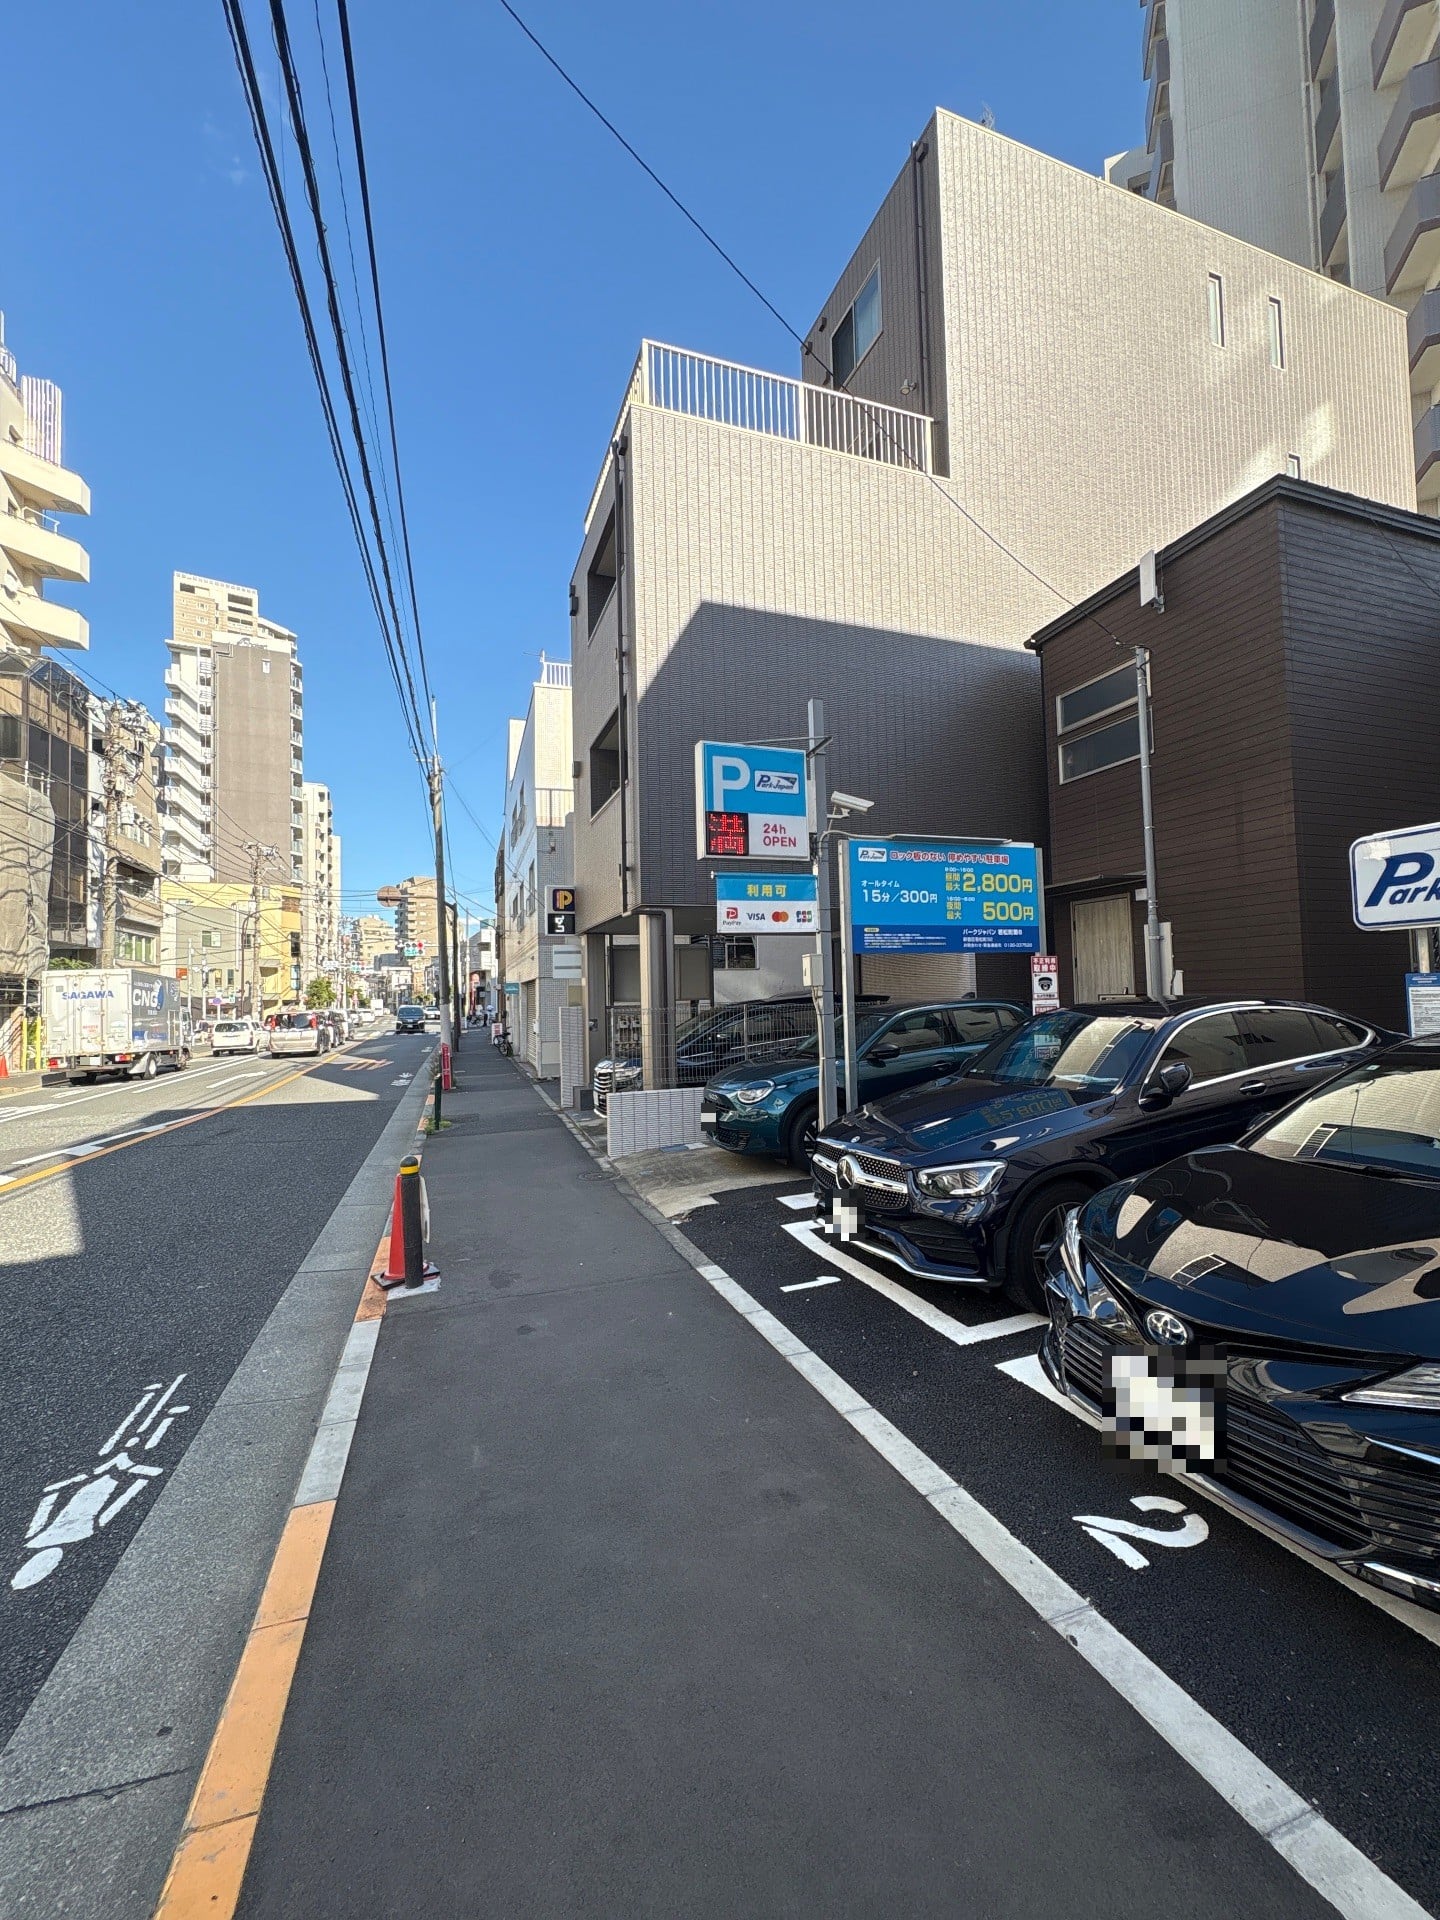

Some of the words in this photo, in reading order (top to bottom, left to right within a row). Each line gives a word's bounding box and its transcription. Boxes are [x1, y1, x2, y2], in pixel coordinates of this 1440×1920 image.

[712, 755, 751, 812] P
[763, 823, 786, 835] 24h
[763, 836, 797, 848] OPEN
[860, 880, 900, 888] オールタイム
[963, 873, 1033, 893] 2,800円
[746, 883, 787, 898] 利用可
[746, 912, 766, 921] VISA
[983, 901, 1034, 921] 500円
[962, 928, 997, 936] パークジャパン
[62, 990, 114, 1001] SAGAWA
[132, 988, 158, 1008] CNG
[1072, 1495, 1209, 1571] 2
